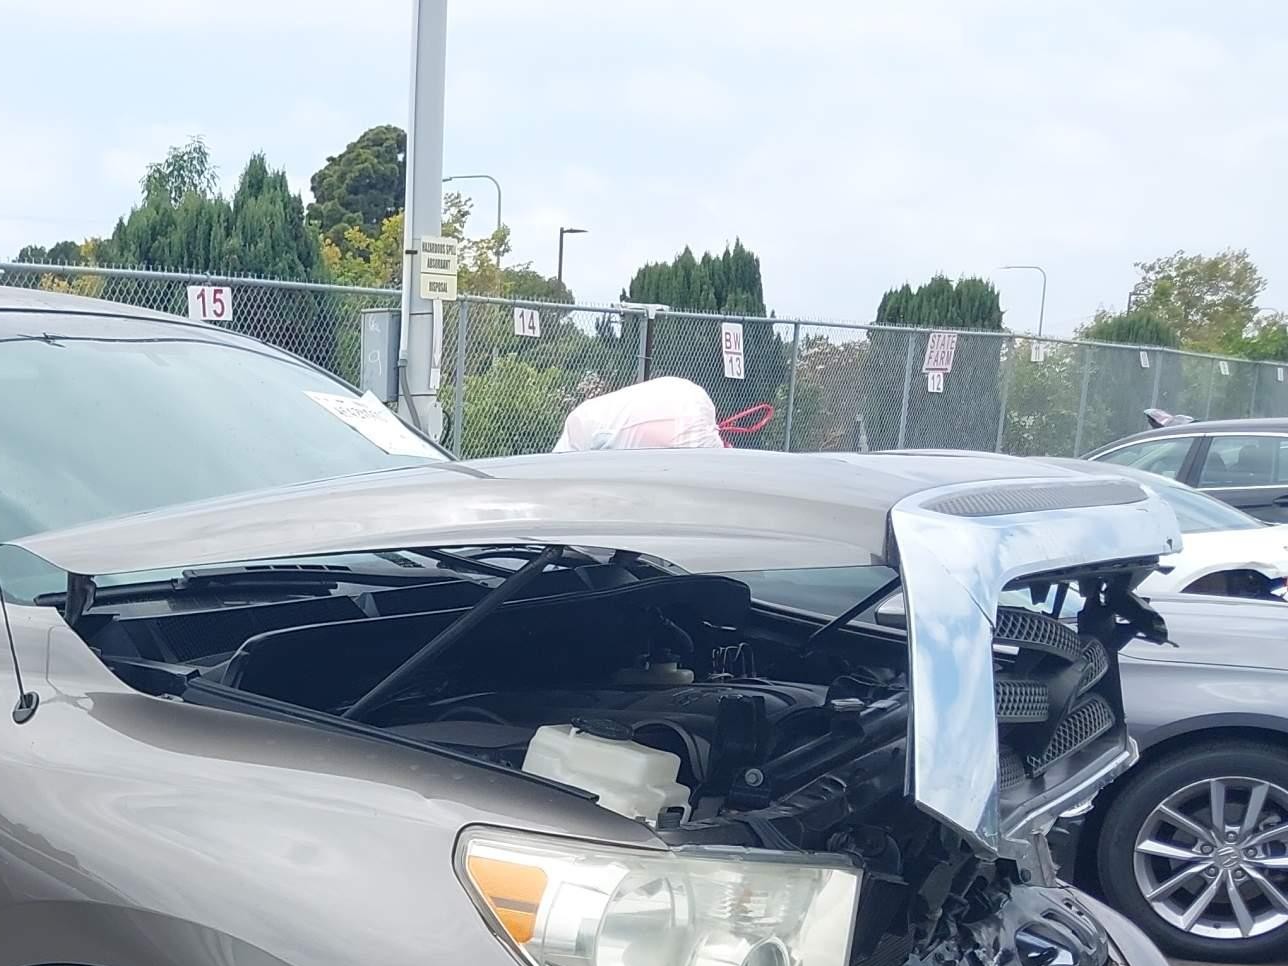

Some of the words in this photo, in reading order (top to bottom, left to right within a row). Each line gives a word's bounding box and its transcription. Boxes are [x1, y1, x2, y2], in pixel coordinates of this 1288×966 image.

[428, 281, 448, 293] DISPOSAL
[196, 288, 225, 318] 15
[519, 310, 536, 335] 14
[929, 334, 957, 350] STATE
[728, 356, 742, 377] 13
[925, 350, 953, 367] FARM
[931, 373, 942, 391] 12
